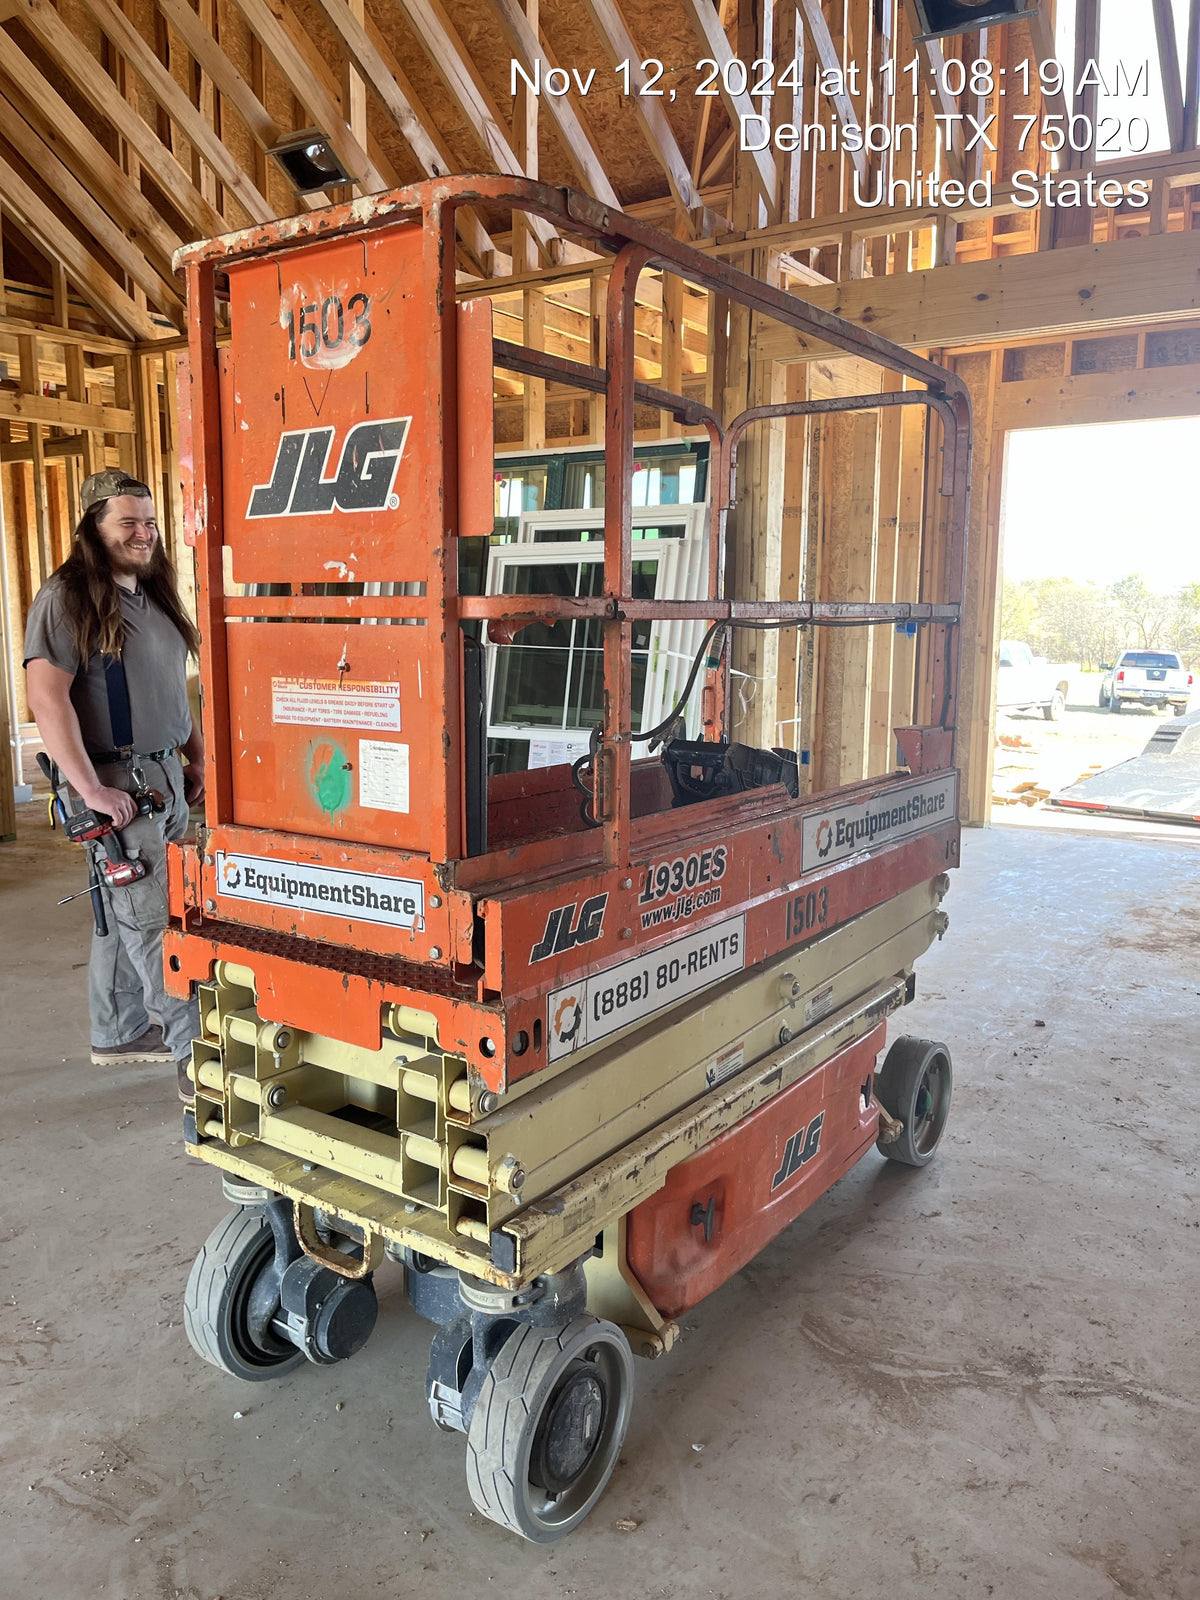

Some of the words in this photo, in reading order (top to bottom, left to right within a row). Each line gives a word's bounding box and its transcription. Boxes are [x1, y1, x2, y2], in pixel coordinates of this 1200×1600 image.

[283, 293, 372, 360] 1503
[245, 416, 413, 520] JLG
[300, 682, 337, 691] CUSTOMER
[835, 792, 945, 848] EquipmentShare
[244, 867, 416, 915] EquipmentShare
[639, 845, 727, 905] 1930ES
[529, 892, 609, 965] JLG
[641, 887, 721, 928] www.jlg.com
[786, 885, 829, 941] 1503
[594, 971, 649, 1021] (888)
[656, 932, 739, 989] 80-RENTS
[771, 1109, 825, 1192] JLG
